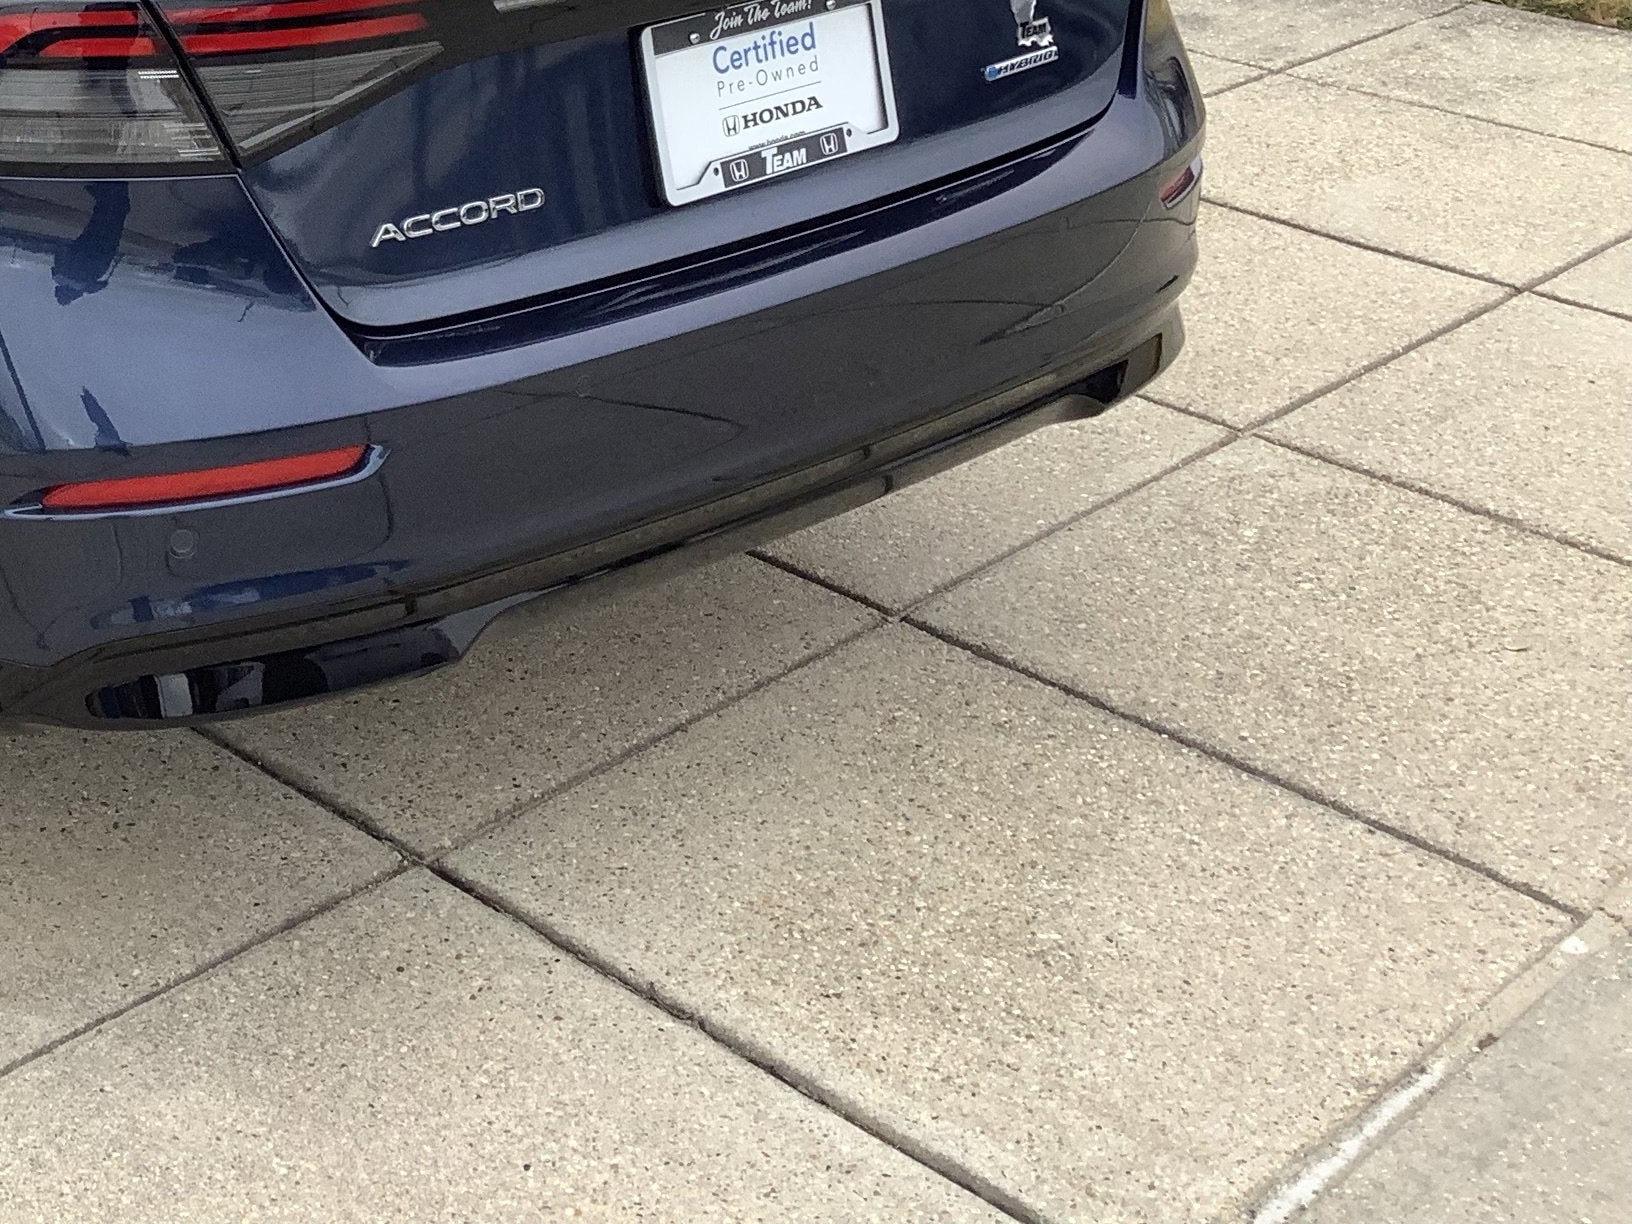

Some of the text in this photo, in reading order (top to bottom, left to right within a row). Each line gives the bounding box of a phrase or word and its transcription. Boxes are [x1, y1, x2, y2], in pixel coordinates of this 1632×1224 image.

[709, 10, 744, 41] Join
[743, 3, 771, 26] The
[1020, 22, 1047, 39] TEAM
[712, 20, 817, 74] Certified
[716, 54, 820, 97] Pre-Owned
[742, 95, 824, 129] HONDA
[761, 147, 808, 175] TEAM
[370, 188, 545, 248] ACCORD
